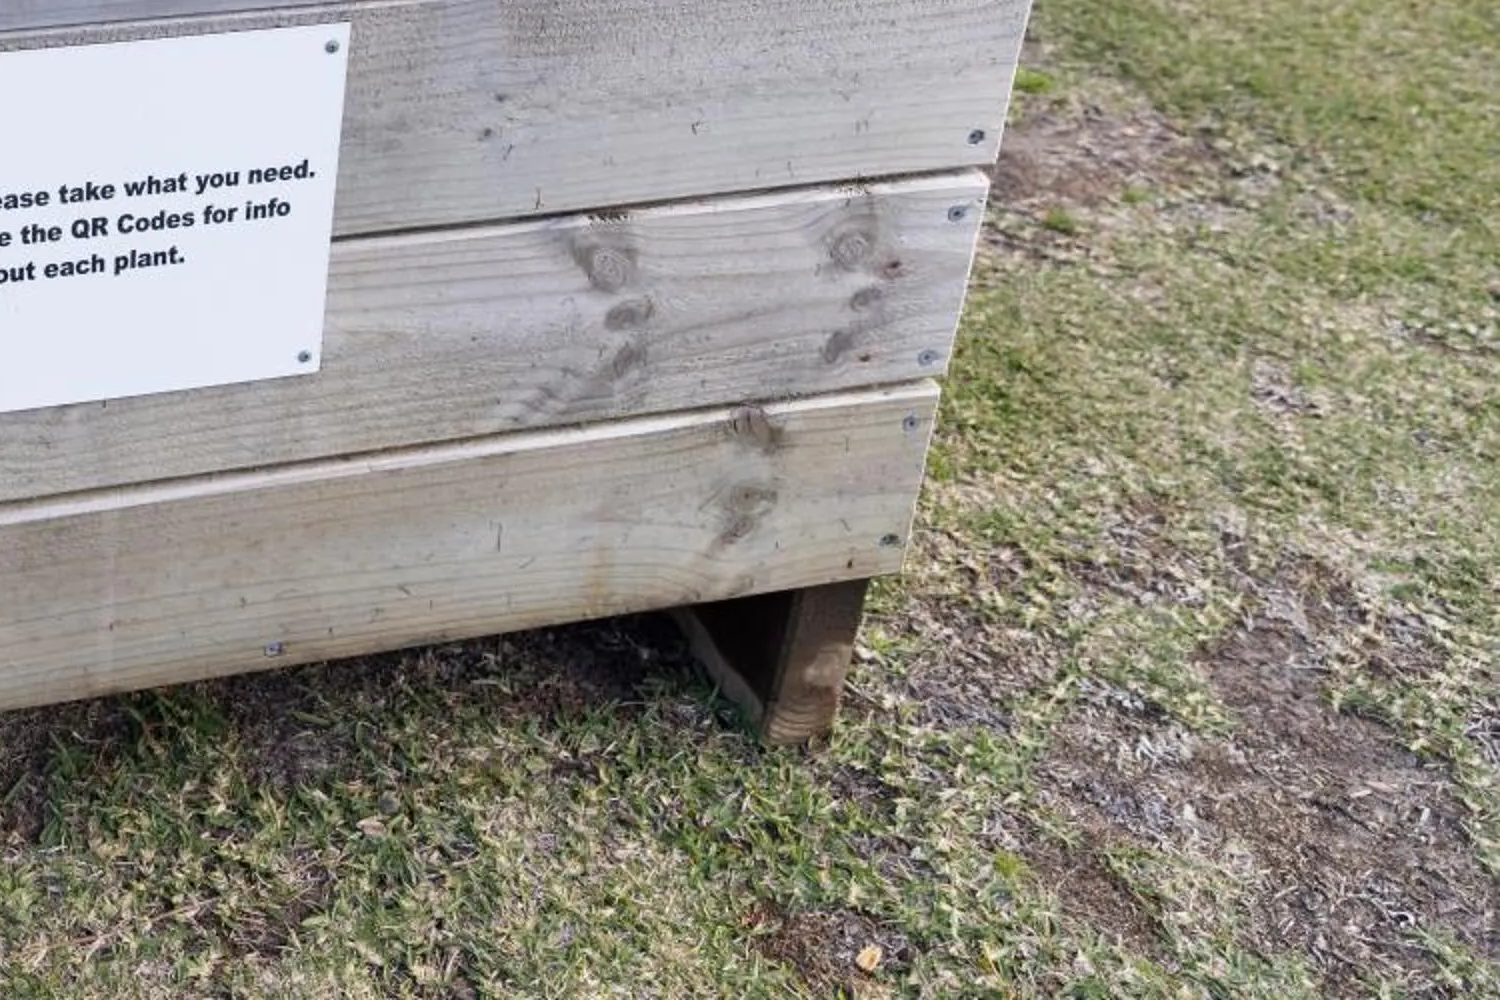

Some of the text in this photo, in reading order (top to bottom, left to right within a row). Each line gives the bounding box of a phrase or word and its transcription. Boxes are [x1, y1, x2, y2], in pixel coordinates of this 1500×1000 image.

[58, 180, 116, 205] take
[123, 172, 188, 197] what
[195, 171, 240, 196] you
[247, 159, 316, 185] need.
[19, 222, 63, 245] the
[70, 216, 109, 240] QR
[116, 208, 196, 236] Codes
[203, 204, 239, 226] for
[245, 197, 291, 221] info
[43, 253, 105, 280] each
[113, 245, 185, 276] plant.
